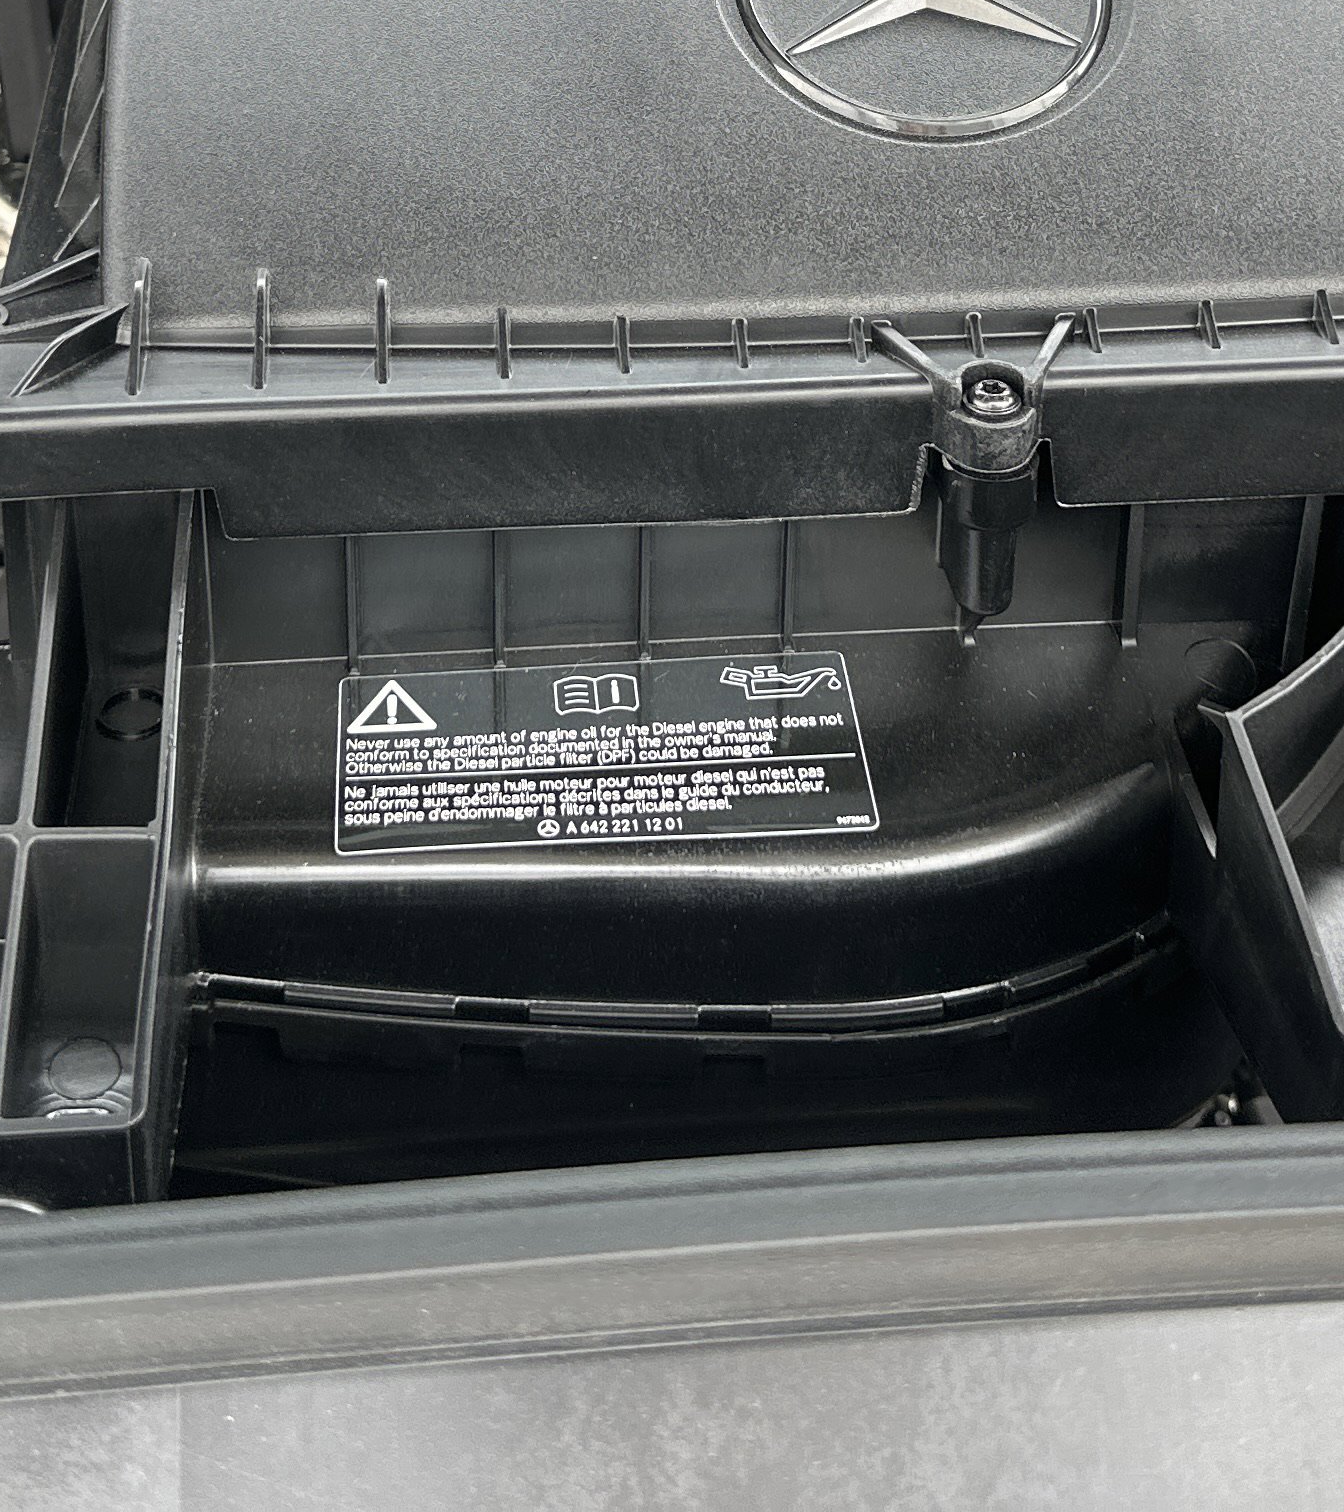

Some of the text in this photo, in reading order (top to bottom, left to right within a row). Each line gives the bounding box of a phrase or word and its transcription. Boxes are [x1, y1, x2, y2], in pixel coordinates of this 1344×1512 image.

[346, 713, 844, 750] Never use any amount of engine oil for the Diesel engine that does not
[346, 729, 776, 762] conform to specification documented in the owner's manual.
[346, 742, 773, 774] Otherwise the Diesel particle filter (DPF) could be damaged.
[345, 765, 825, 799] Ne jamais utiliser une huile moteur pour moteur diesel qui n'est pas
[345, 779, 830, 811] conforme aux spécifications décrites dans le guide du conducteur,
[344, 795, 732, 827] sous peine d'endommager le filtre à particules diesel.
[565, 818, 683, 835] A 642 221 12 01
